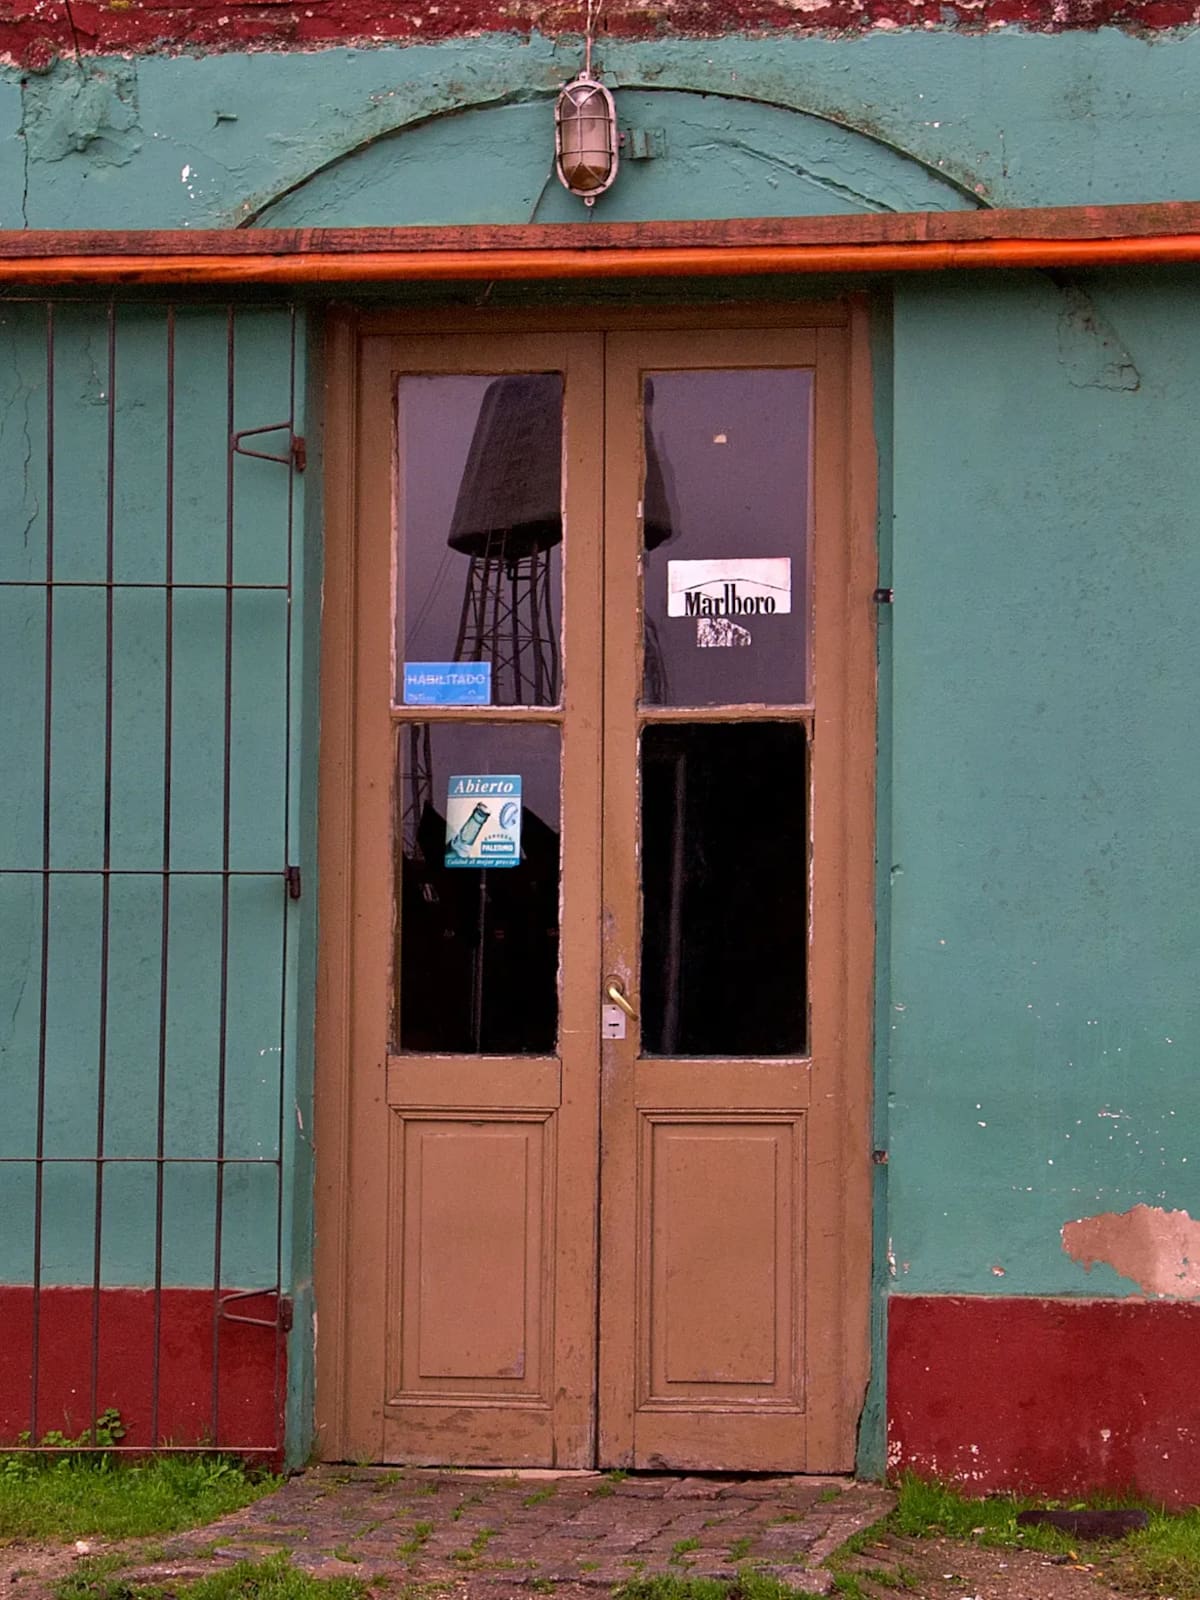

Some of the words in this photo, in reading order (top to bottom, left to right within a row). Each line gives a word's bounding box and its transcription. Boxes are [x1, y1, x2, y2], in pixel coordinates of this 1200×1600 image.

[684, 583, 776, 616] Marlboro
[406, 673, 486, 685] HABILITADO
[454, 779, 514, 793] Abierto
